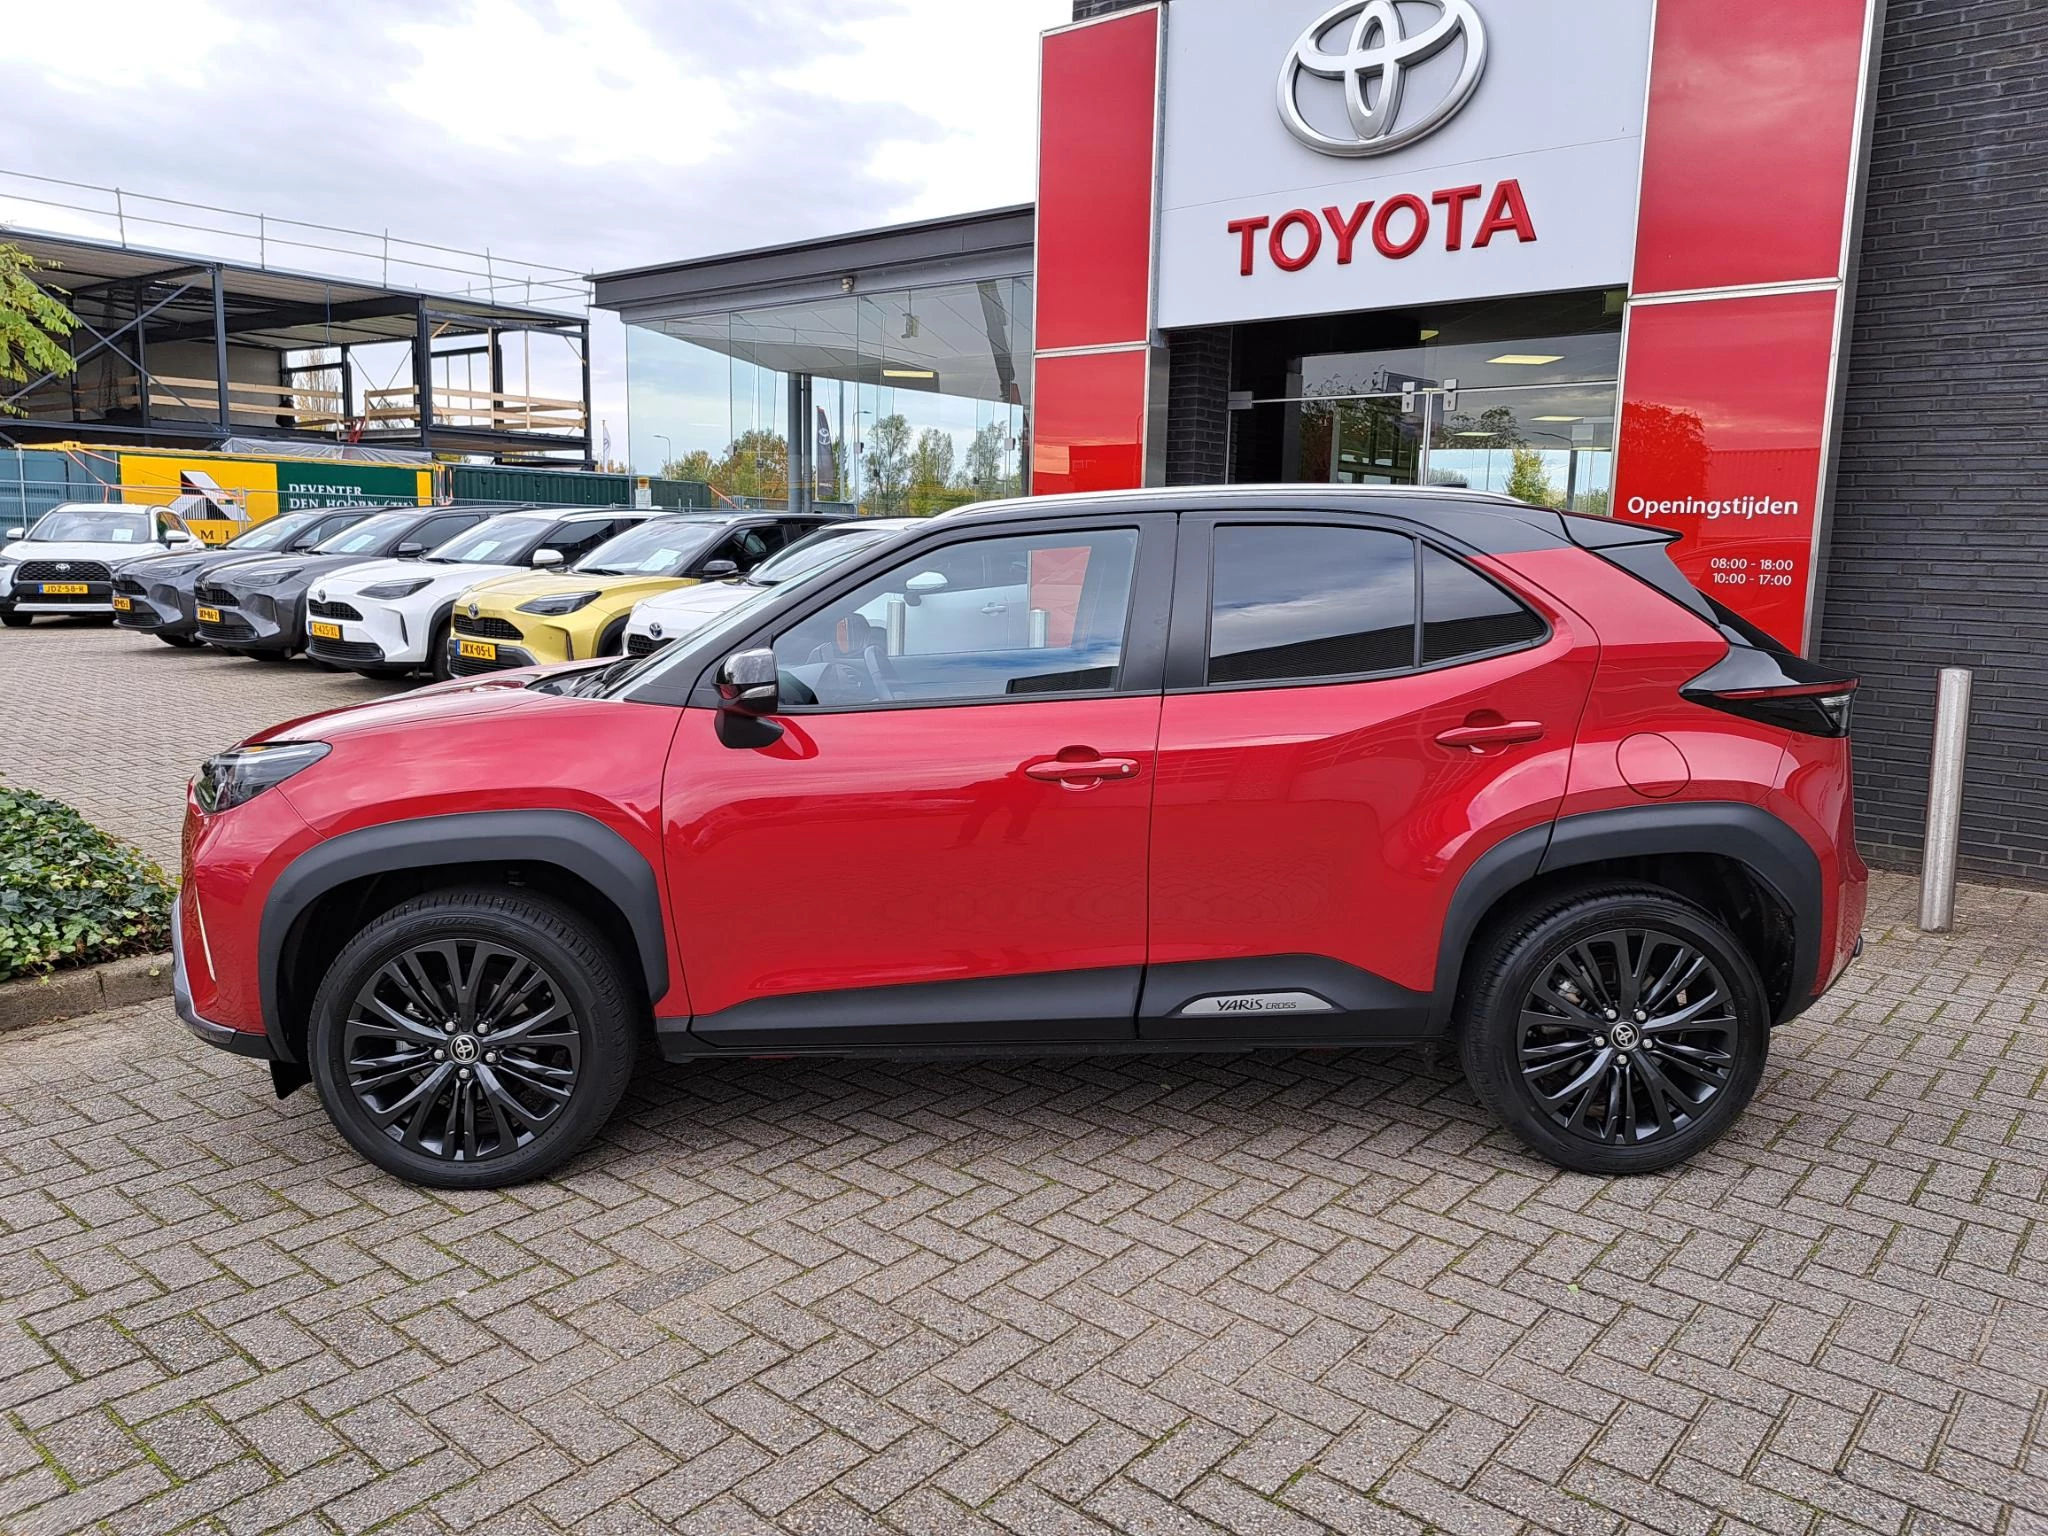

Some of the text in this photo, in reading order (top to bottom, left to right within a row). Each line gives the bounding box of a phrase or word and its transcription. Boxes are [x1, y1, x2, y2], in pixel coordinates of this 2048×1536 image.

[1227, 178, 1537, 276] TOYOTA
[289, 483, 362, 496] DEVENTER
[289, 498, 319, 509] DEN
[1627, 496, 1798, 519] Openingstijden
[1710, 558, 1747, 569] 08:00
[1760, 559, 1793, 571] 18:00
[1713, 573, 1746, 584] 10:00
[1759, 574, 1792, 586] 17:00
[461, 642, 493, 657] JKX-05-L
